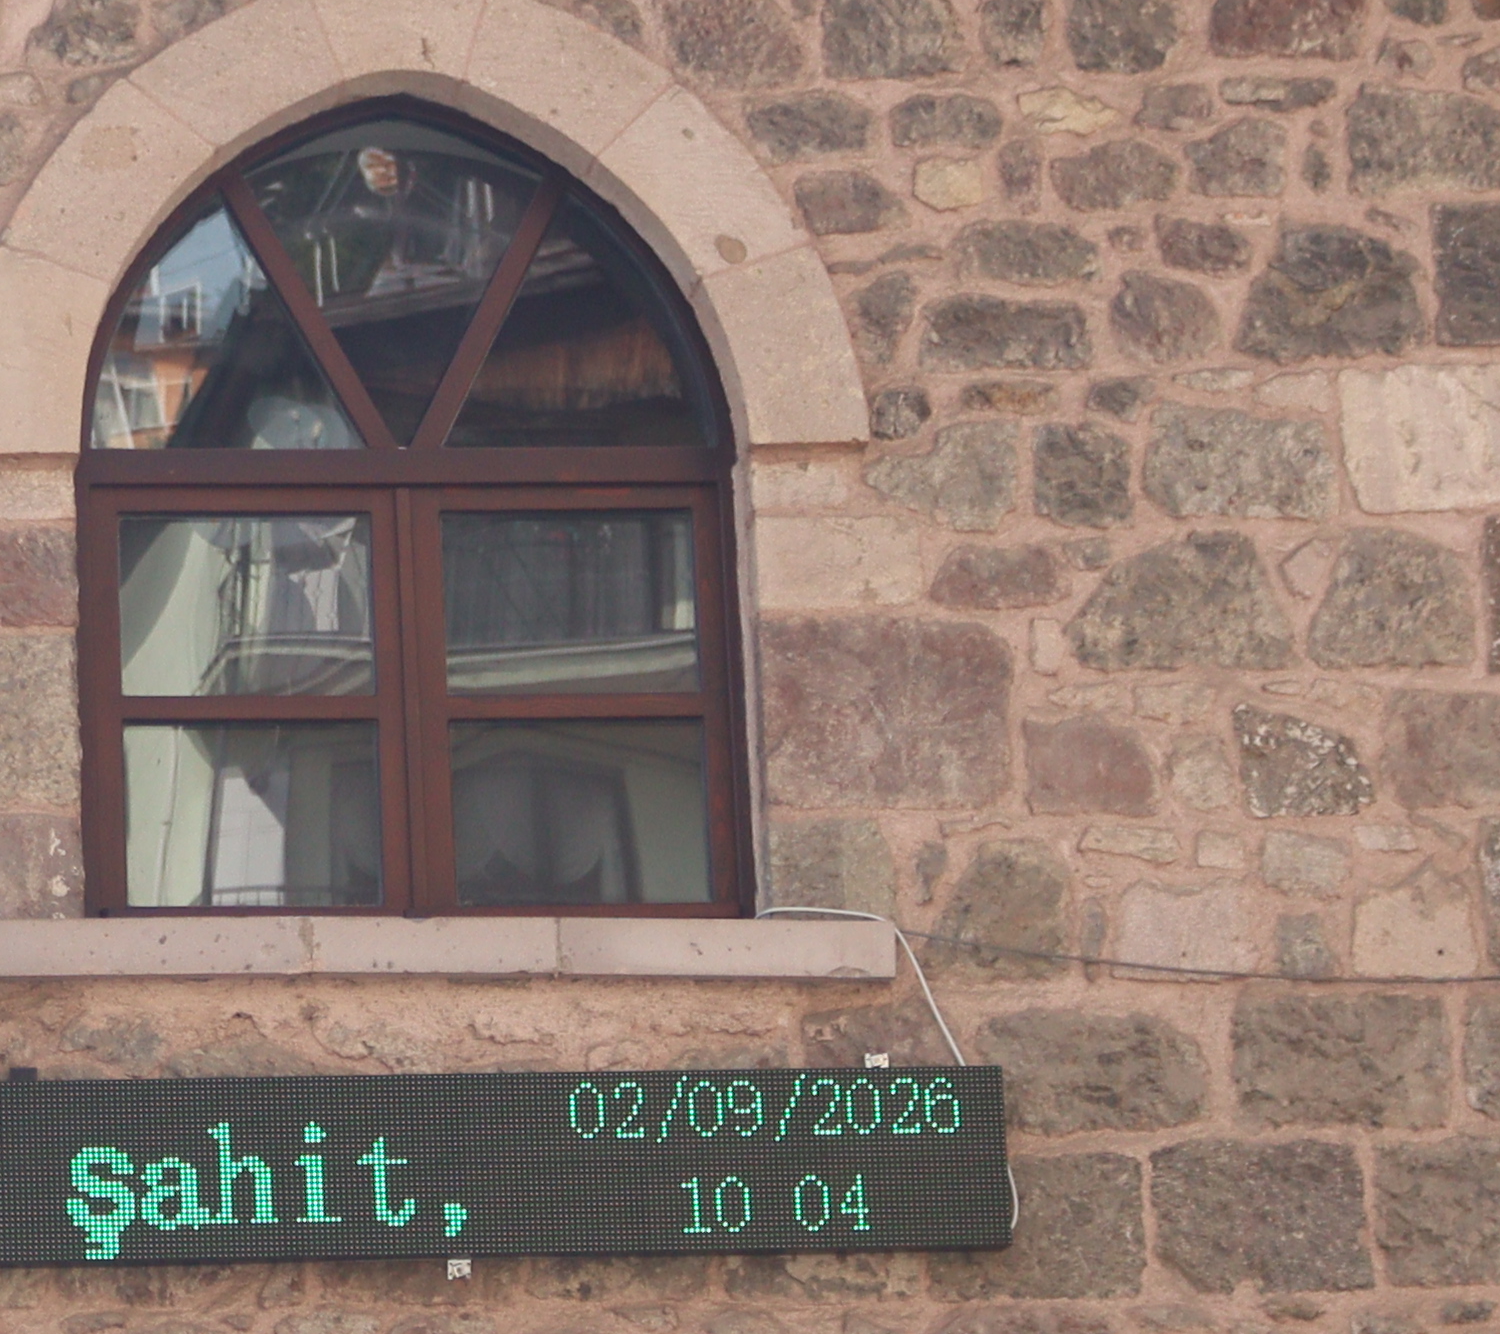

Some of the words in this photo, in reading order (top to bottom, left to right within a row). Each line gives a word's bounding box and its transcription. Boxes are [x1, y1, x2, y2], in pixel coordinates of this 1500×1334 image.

[570, 1075, 960, 1143] 02/09/2026
[680, 1176, 751, 1234] 10
[794, 1174, 871, 1232] 04
